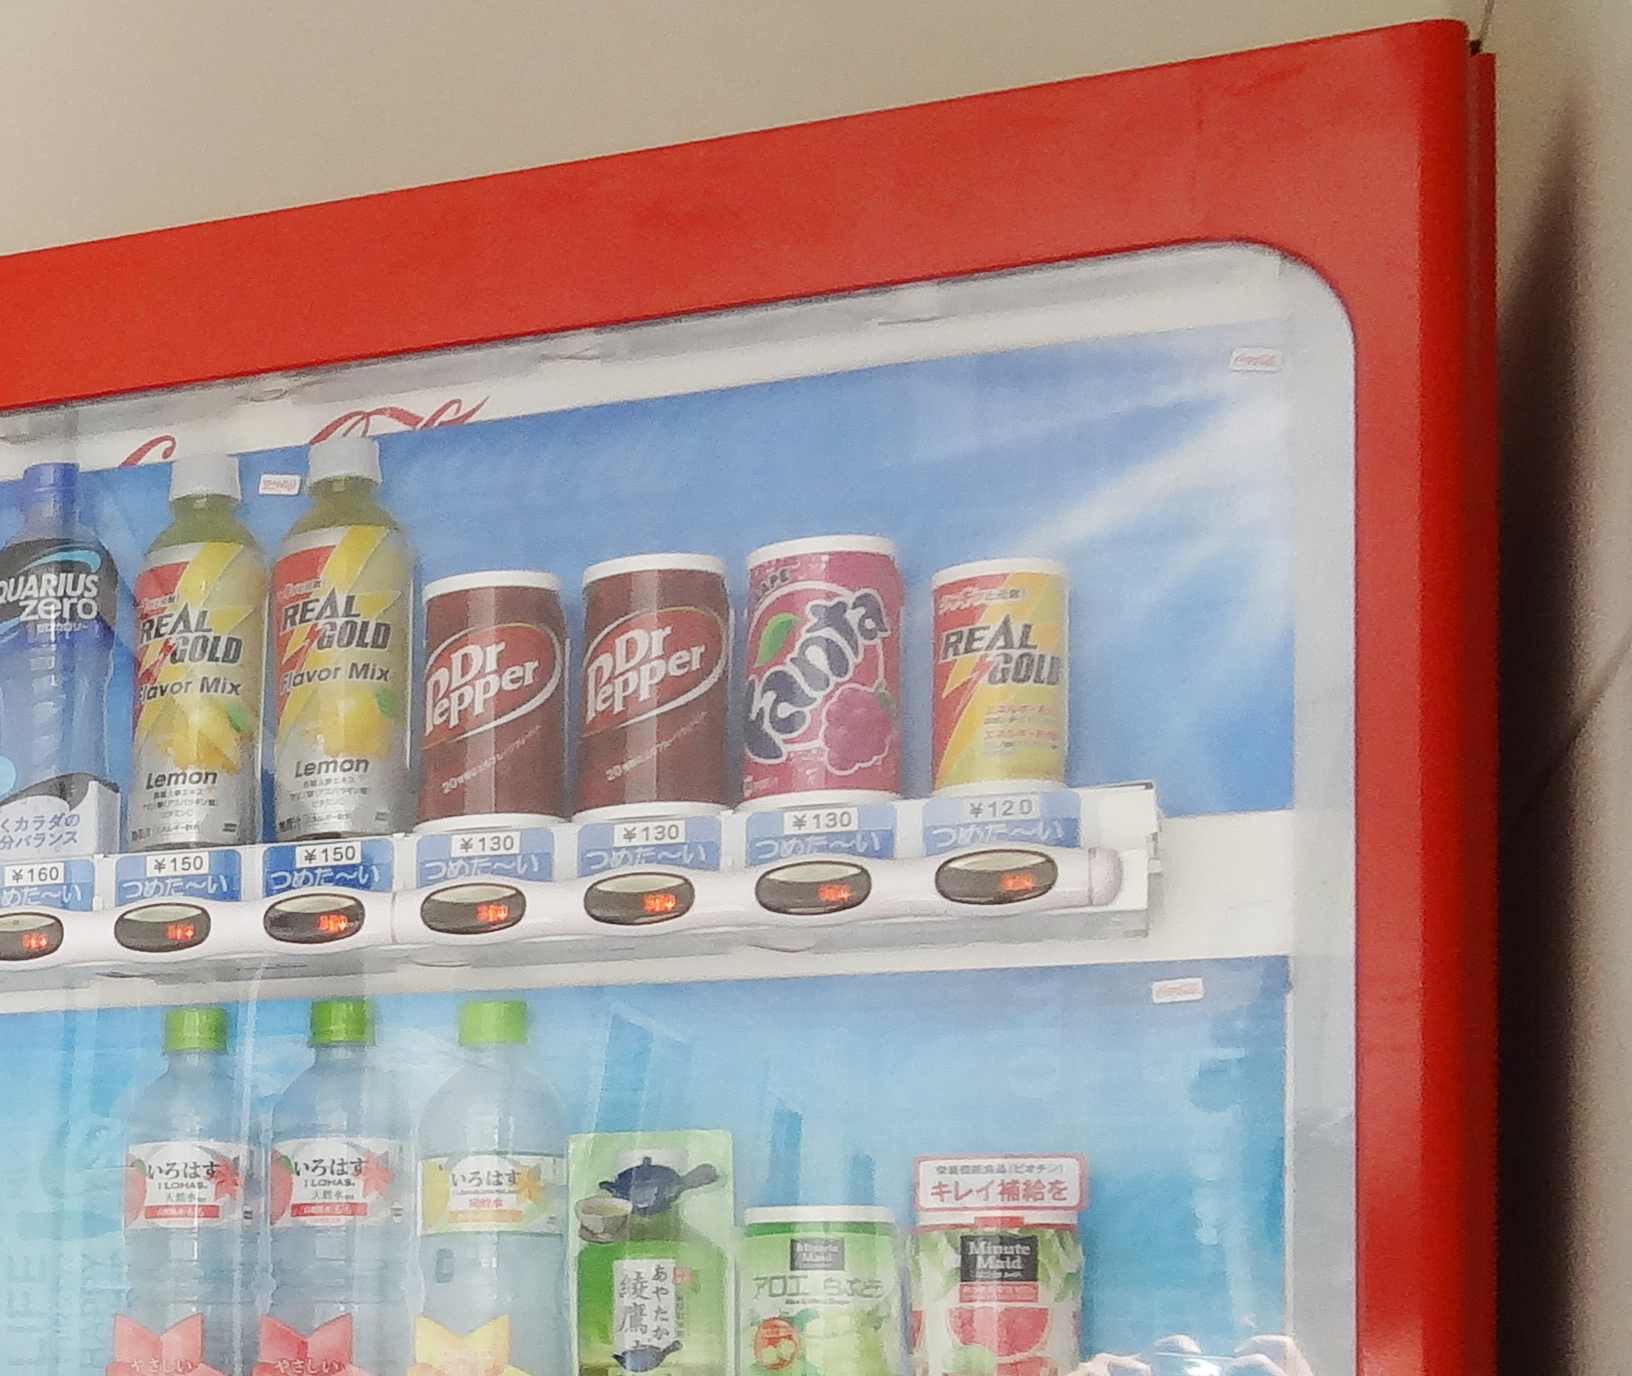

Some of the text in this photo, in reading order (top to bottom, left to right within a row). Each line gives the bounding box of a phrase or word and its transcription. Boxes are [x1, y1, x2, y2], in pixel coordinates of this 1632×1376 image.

[19, 595, 98, 622] zero
[282, 587, 391, 651] REAL GOLD
[141, 604, 243, 666] REAL GOLD
[941, 614, 1038, 662] REAL
[448, 632, 506, 677] Dr
[349, 660, 390, 683] Mix
[586, 622, 707, 727] Dr Pepper
[744, 590, 891, 763] Fanta
[198, 675, 242, 698] Mix
[426, 656, 540, 736] Pepper
[294, 756, 370, 779] Lemon
[145, 769, 218, 791] Lemon
[969, 798, 1034, 818] ¥120
[792, 811, 853, 830] ¥130
[621, 822, 681, 843] ¥130
[303, 845, 357, 864] ¥150
[459, 835, 516, 853] ¥130
[11, 866, 60, 882] ¥160
[152, 856, 204, 872] ¥150
[147, 1159, 222, 1180] いろはす
[293, 1156, 368, 1178] いろはす
[449, 1170, 521, 1188] いろはす
[930, 1179, 1069, 1203] キレイ補給を
[967, 1240, 1032, 1258] Minute
[976, 1253, 1025, 1270] Maid
[619, 1271, 650, 1337] 綾鷹
[650, 1263, 671, 1341] あやたか
[131, 1358, 193, 1374] やさしい
[274, 1357, 340, 1374] やさしい
